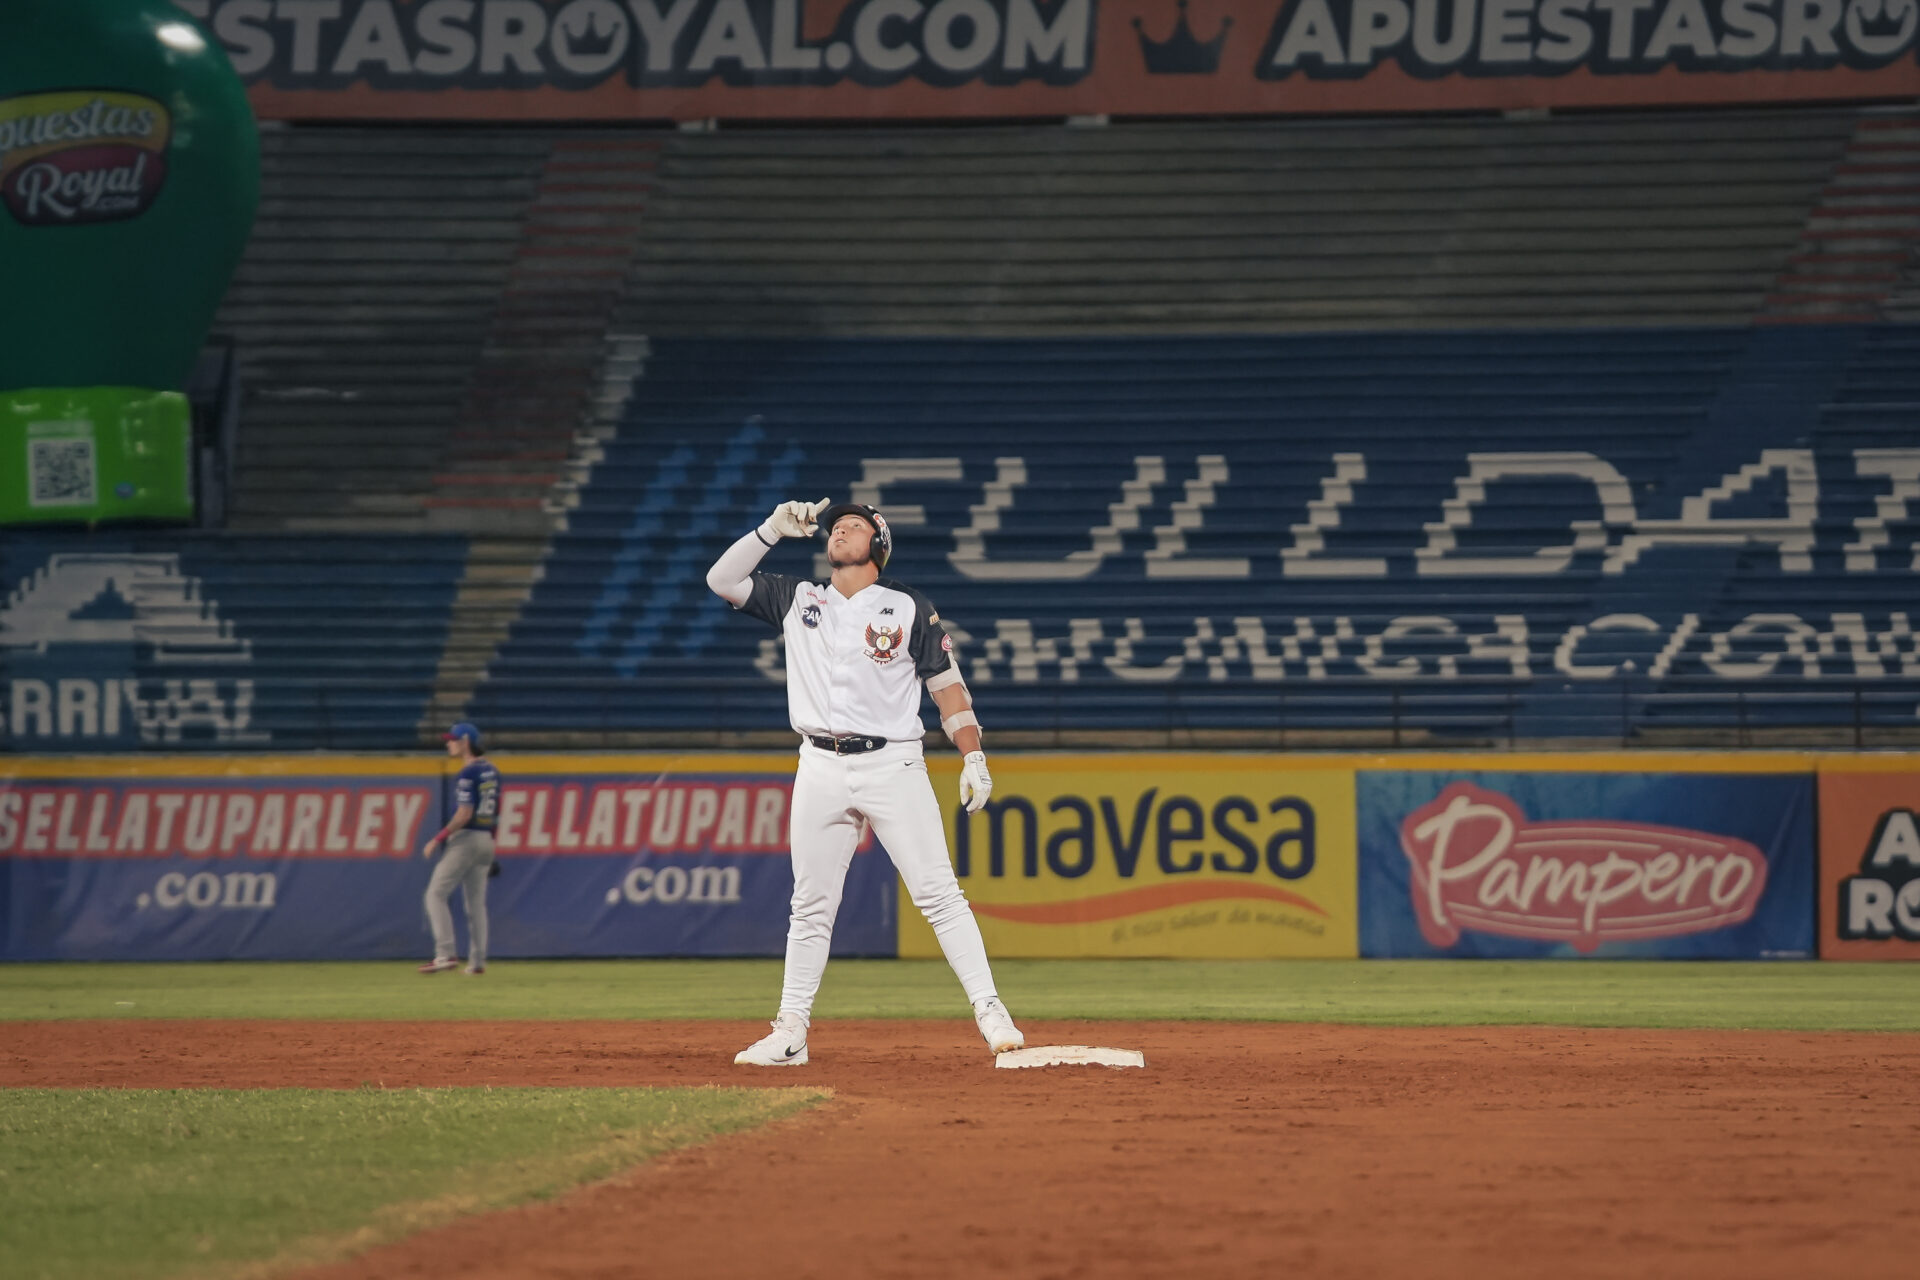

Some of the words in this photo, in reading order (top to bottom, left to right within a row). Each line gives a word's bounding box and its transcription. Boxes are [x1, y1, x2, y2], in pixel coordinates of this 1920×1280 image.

[178, 0, 1087, 76] STASROYAL.COM
[16, 152, 147, 218] Royal
[814, 448, 1920, 579] FULLDAT
[0, 793, 425, 852] SELLATUPARLEY
[499, 788, 868, 848] ELLATUPAR
[956, 787, 1316, 880] mavesa
[137, 872, 277, 908] .com
[605, 864, 741, 904] .com
[1413, 795, 1755, 933] Pampero
